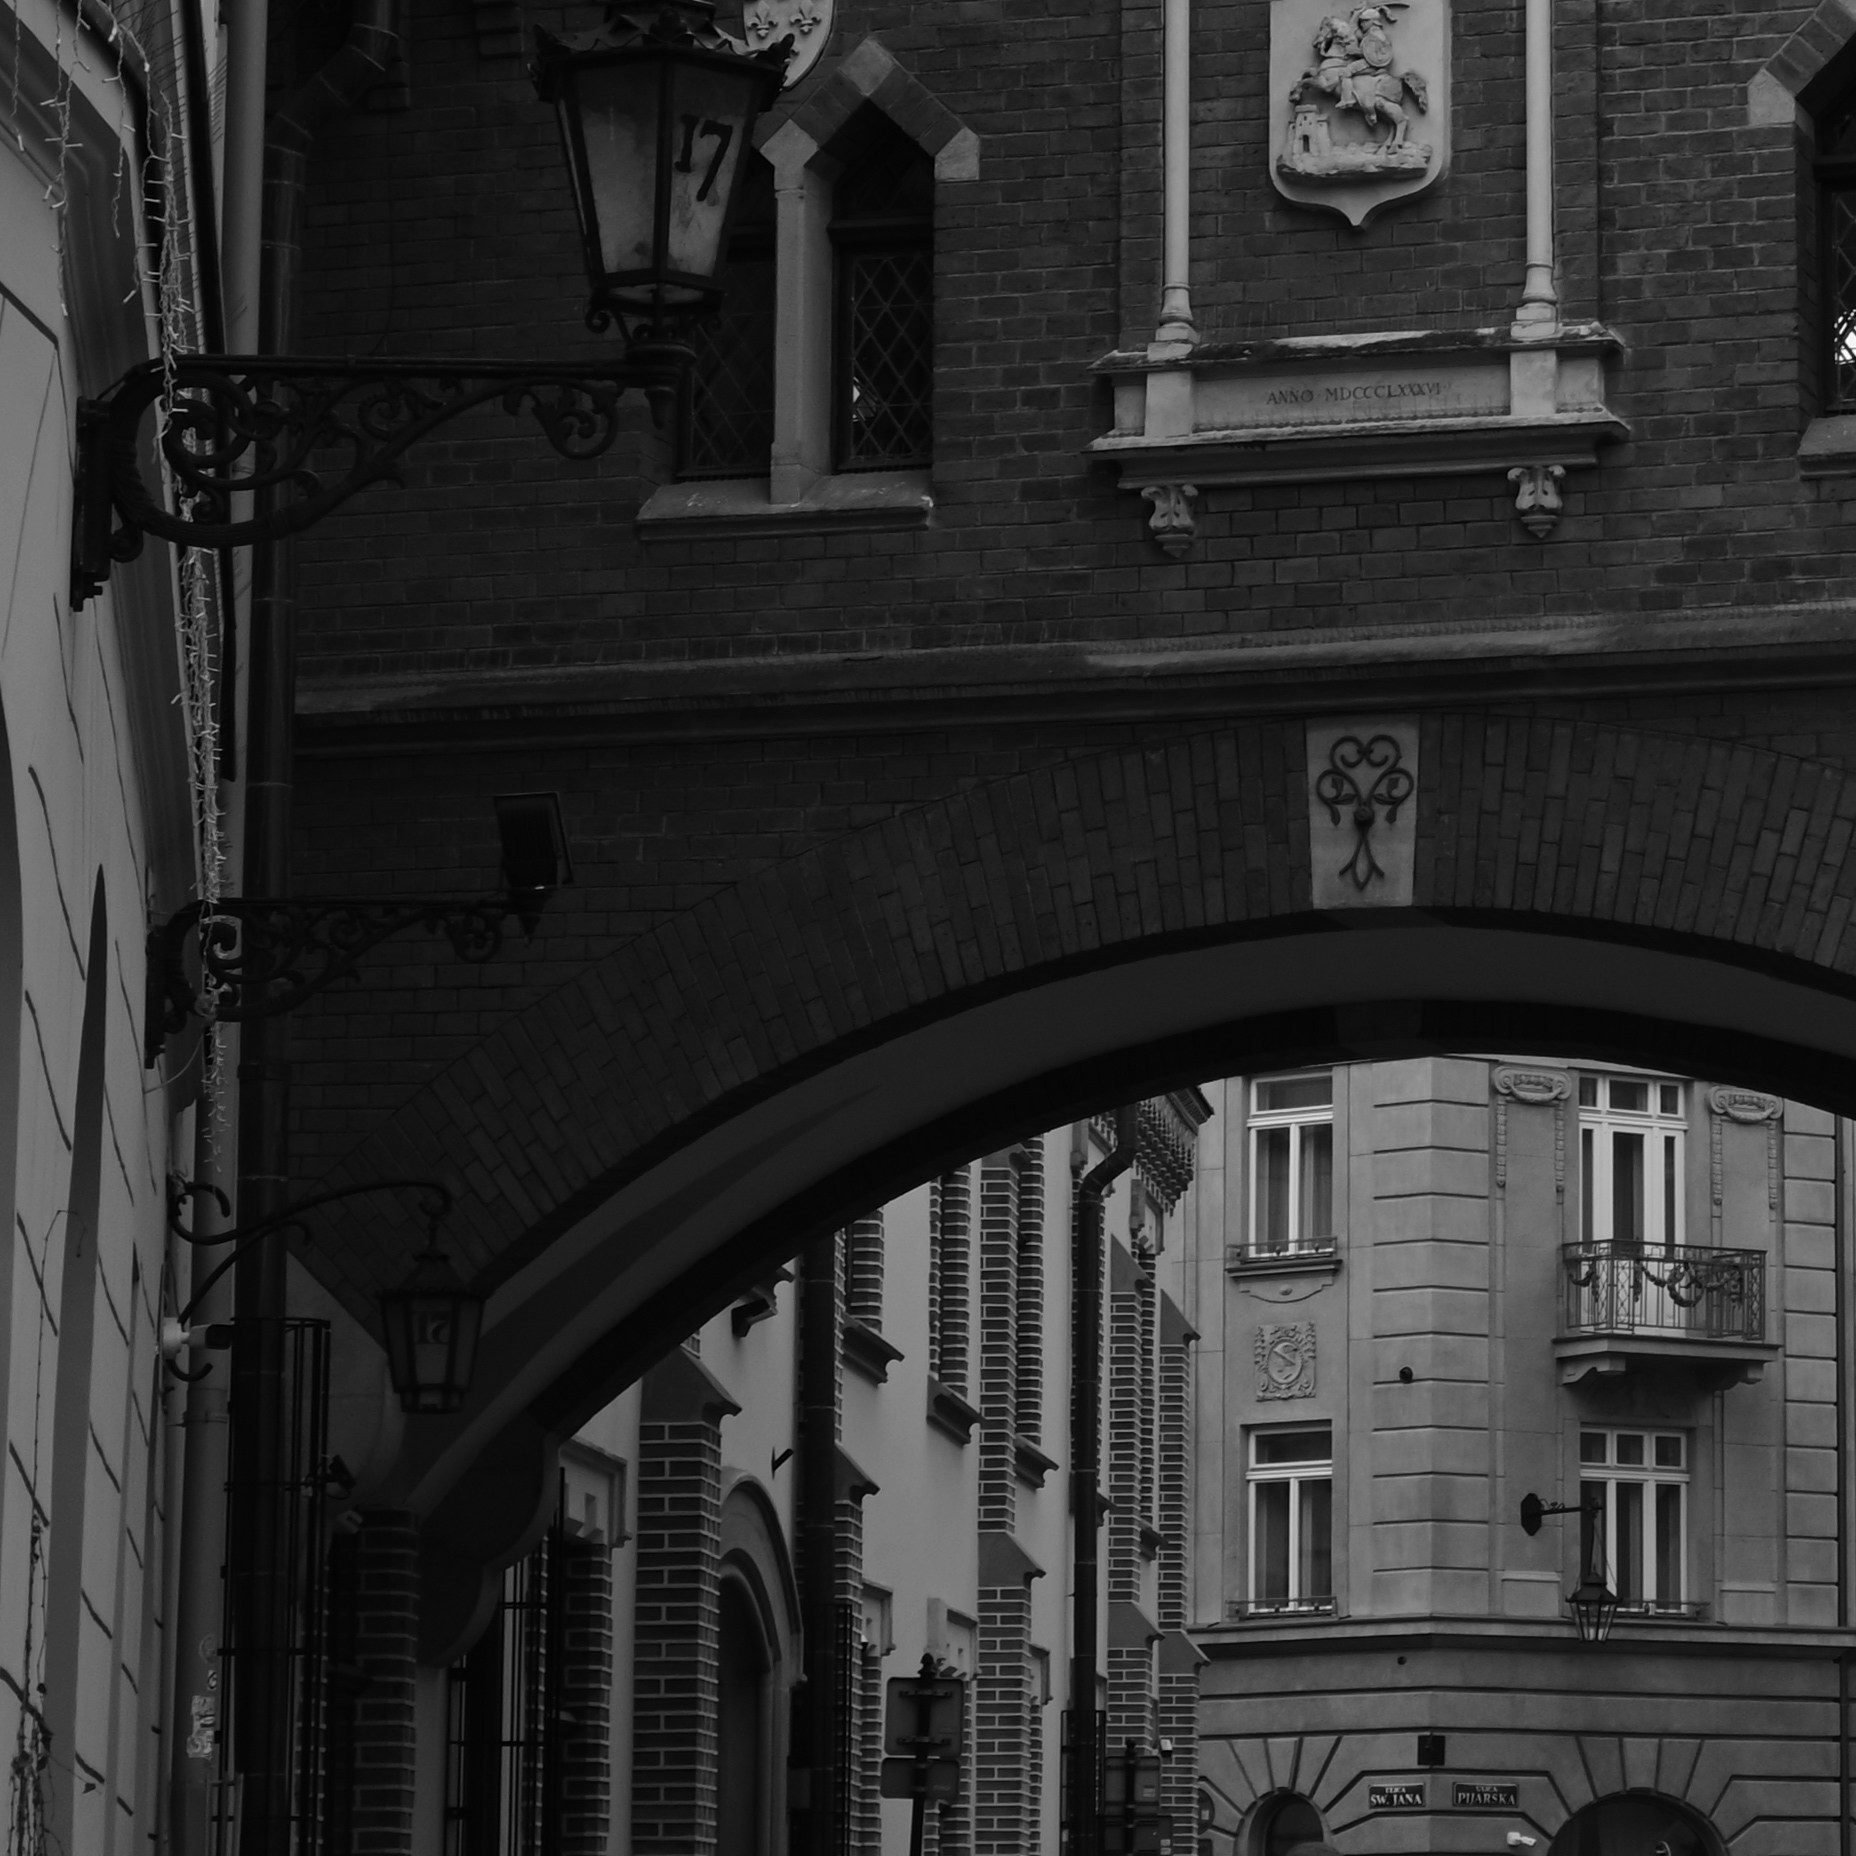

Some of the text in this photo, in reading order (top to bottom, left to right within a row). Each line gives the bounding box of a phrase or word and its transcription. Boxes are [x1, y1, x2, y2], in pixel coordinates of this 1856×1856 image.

[674, 113, 733, 202] 17
[1266, 388, 1314, 405] ANNO
[1392, 1793, 1422, 1806] JANA
[1457, 1792, 1516, 1805] PIJARSKA
